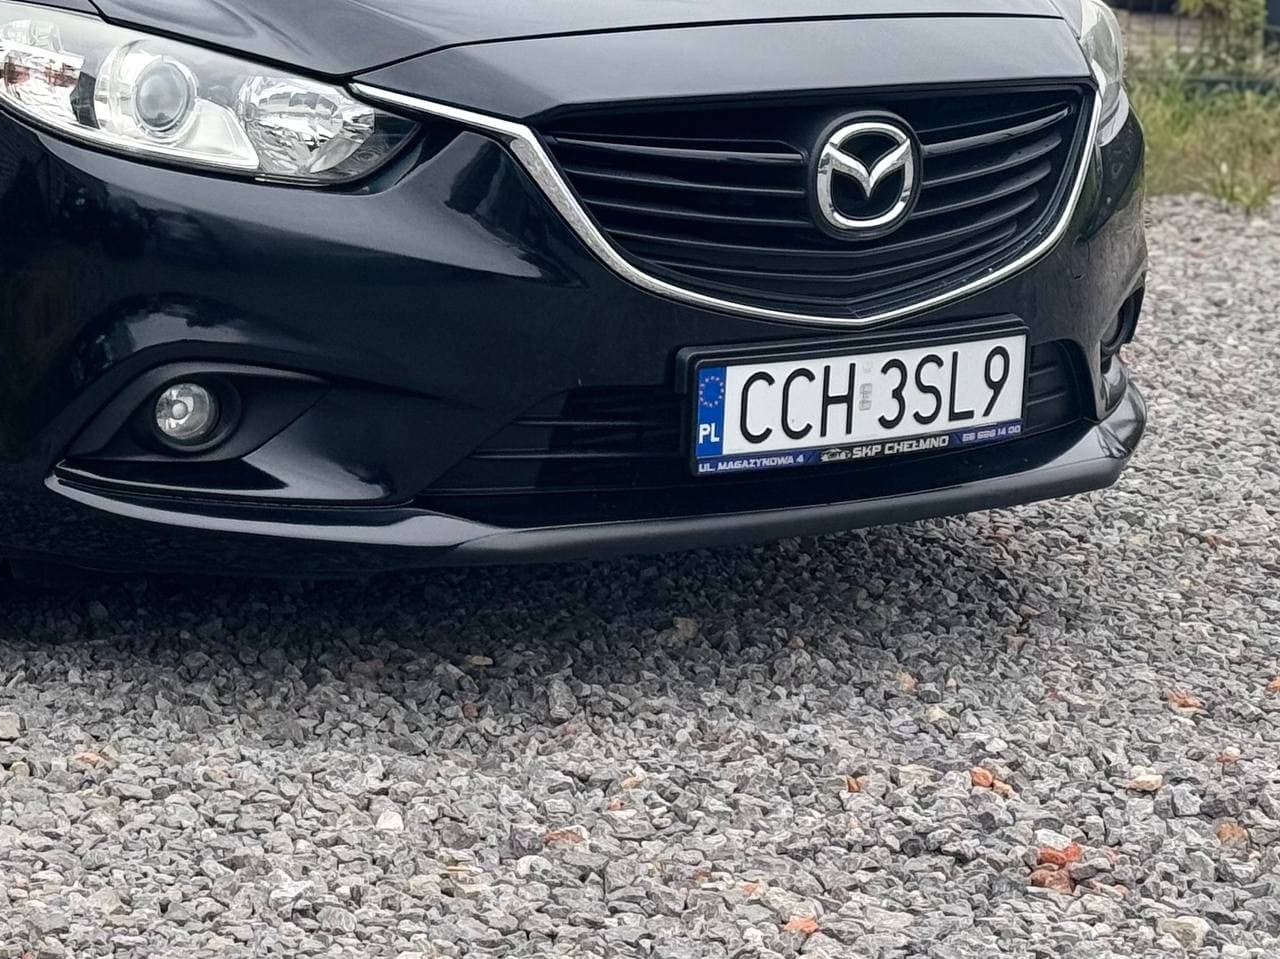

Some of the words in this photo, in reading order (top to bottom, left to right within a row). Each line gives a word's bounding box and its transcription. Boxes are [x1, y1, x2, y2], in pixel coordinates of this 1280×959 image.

[740, 362, 857, 444] CCH
[878, 345, 1011, 429] 3SL9
[698, 423, 720, 445] PL
[717, 455, 794, 471] MAGAZYNOWA
[852, 444, 882, 459] SKP
